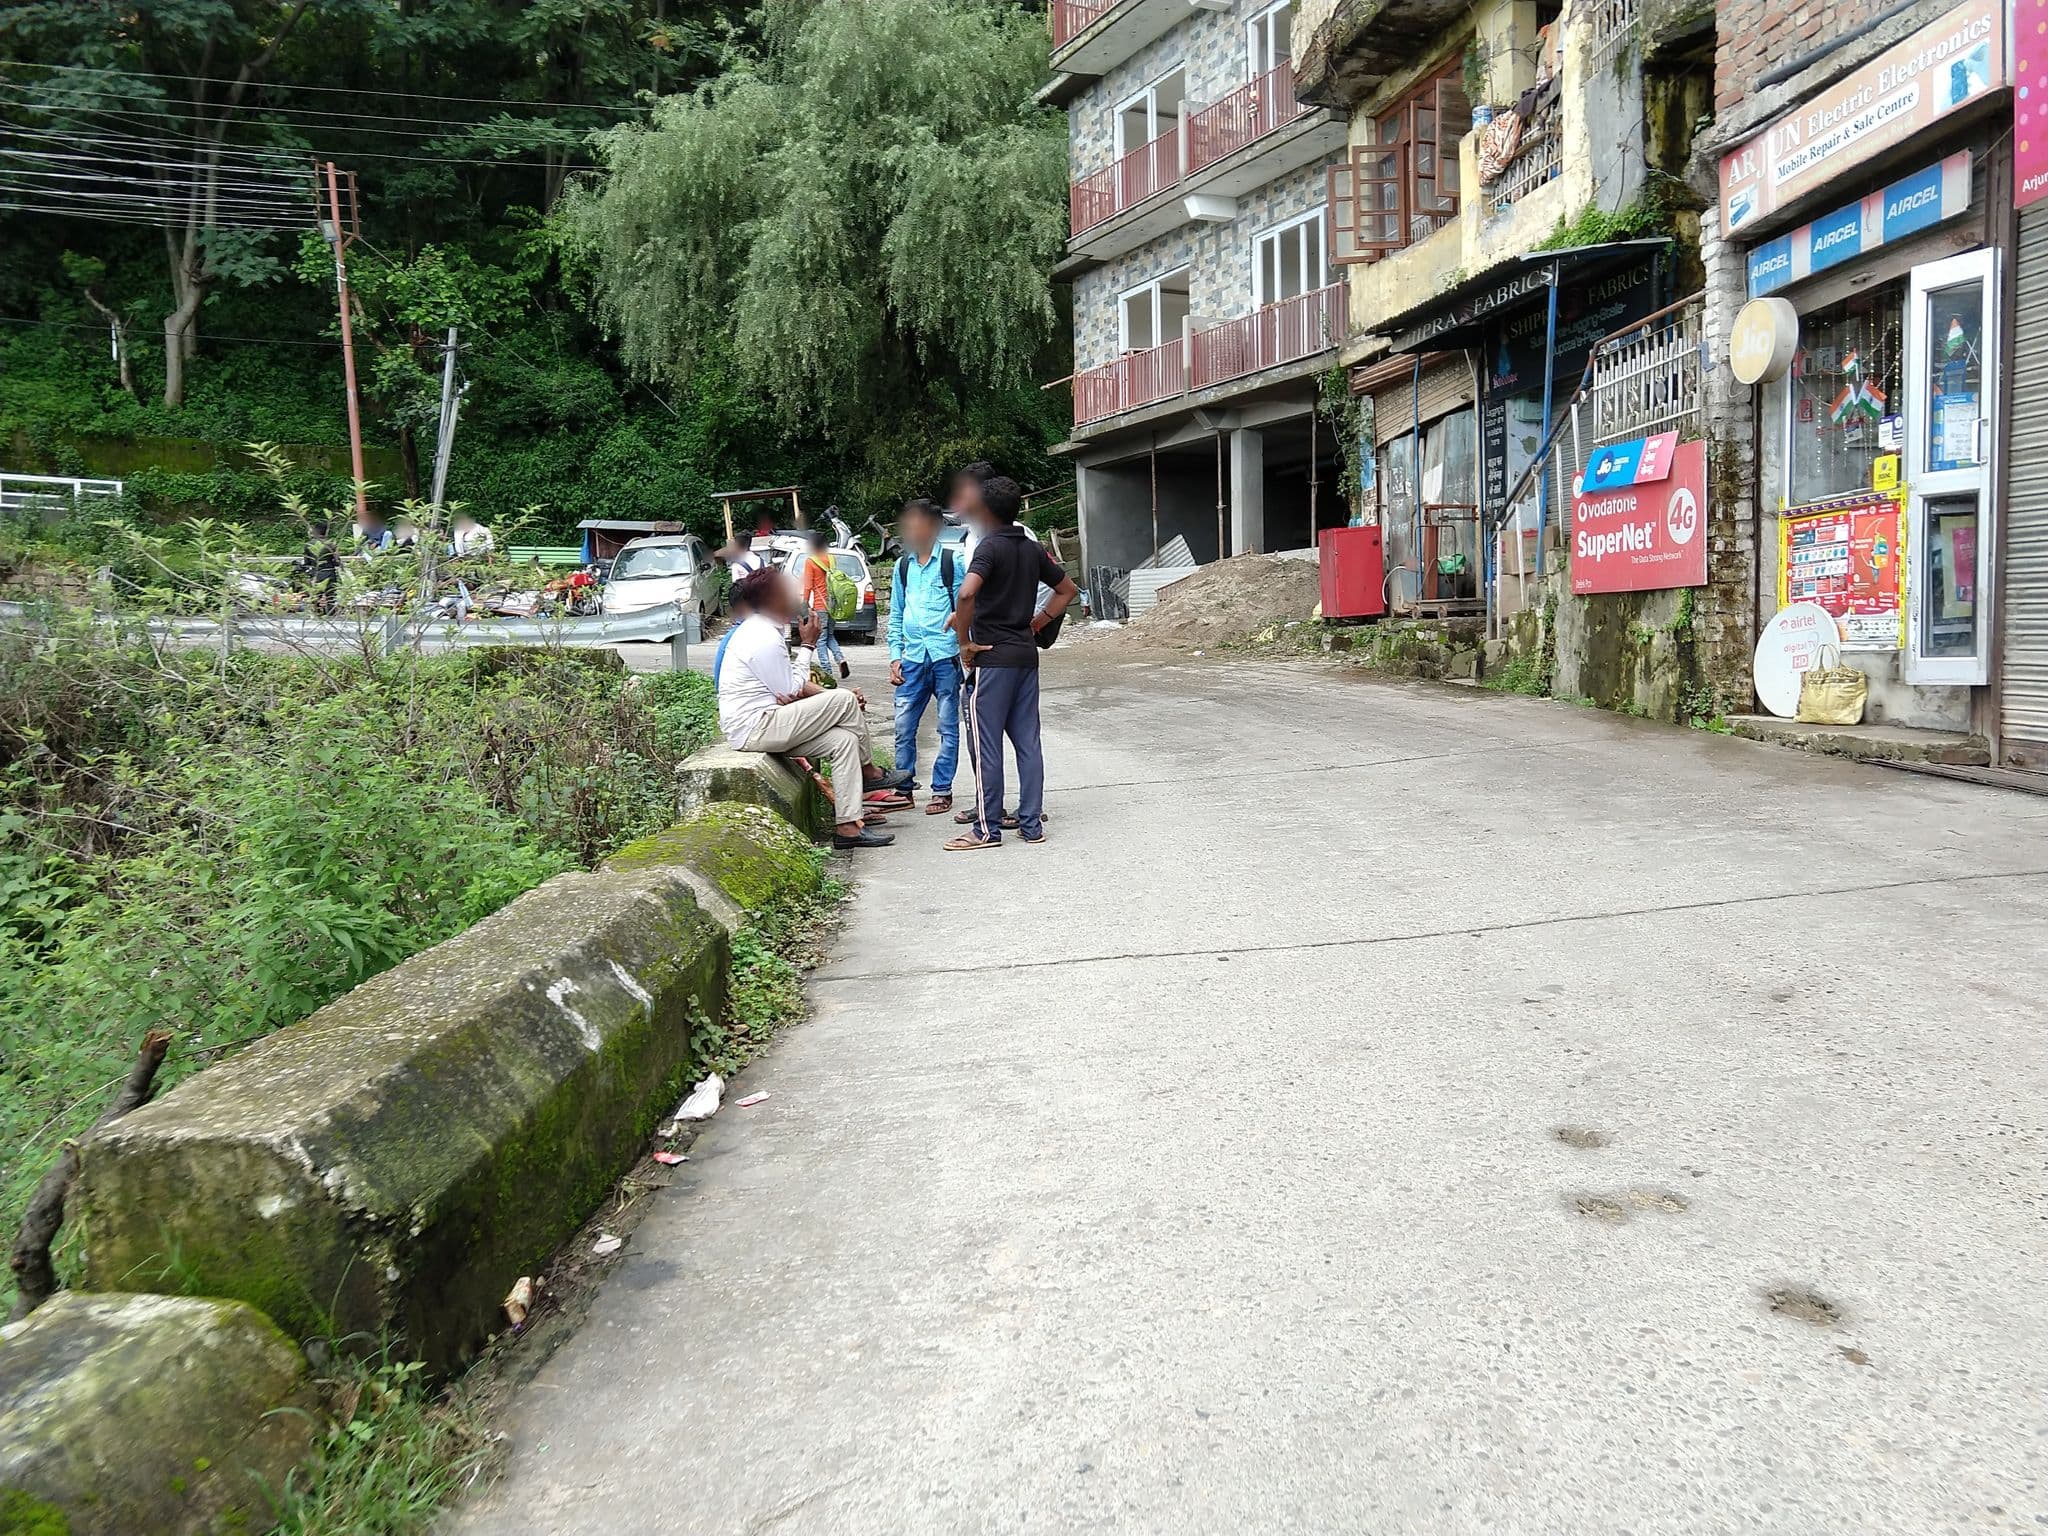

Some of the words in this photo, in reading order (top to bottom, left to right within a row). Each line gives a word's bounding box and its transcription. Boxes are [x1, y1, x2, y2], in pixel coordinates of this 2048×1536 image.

[1807, 83, 1873, 138] Electric
[1878, 12, 1992, 97] Electronics
[1777, 154, 1808, 181] Mobile
[1809, 133, 1842, 158] Repair
[1843, 127, 1851, 139] &
[1852, 113, 1874, 135] Sale
[1876, 90, 1915, 120] Centre
[1887, 184, 1939, 221] AIRCEL
[1813, 221, 1859, 254] AIRCEL
[1750, 252, 1790, 281] AIRCEL
[1402, 311, 1458, 347] HIPRA
[1473, 263, 1553, 315] FABRICS
[1597, 458, 1612, 475] Jio
[1588, 496, 1637, 518] vodafone
[1669, 495, 1694, 532] 4G
[1577, 522, 1653, 562] SuperNet
[1790, 613, 1816, 629] airtel
[1784, 640, 1807, 653] digital
[1793, 654, 1808, 668] HD
